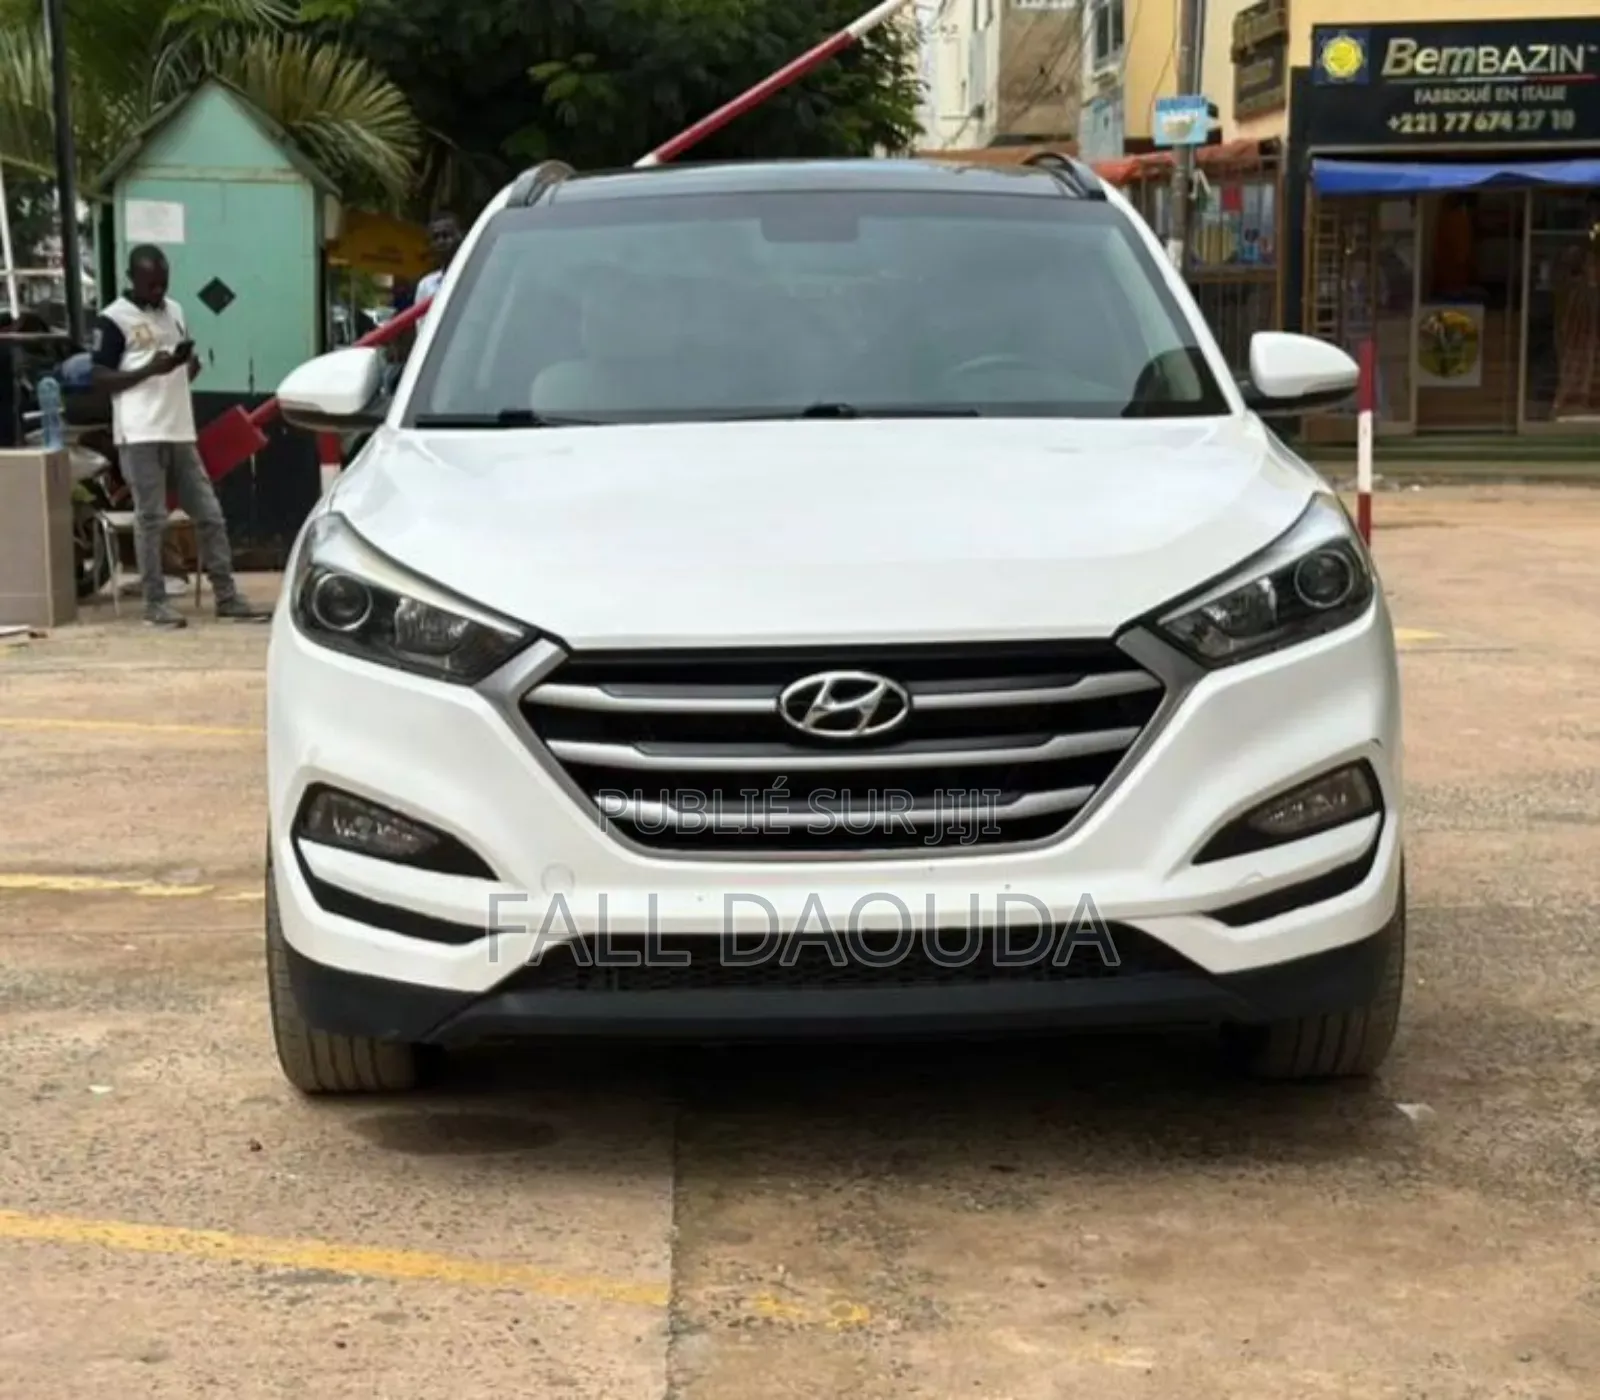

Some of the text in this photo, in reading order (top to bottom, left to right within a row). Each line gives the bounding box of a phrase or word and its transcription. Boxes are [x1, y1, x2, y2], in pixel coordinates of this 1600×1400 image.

[1413, 84, 1568, 104] FABRIQUÉ EN ITALIE
[1386, 112, 1438, 133] +221
[1444, 111, 1473, 132] 77
[1516, 109, 1546, 131] 27
